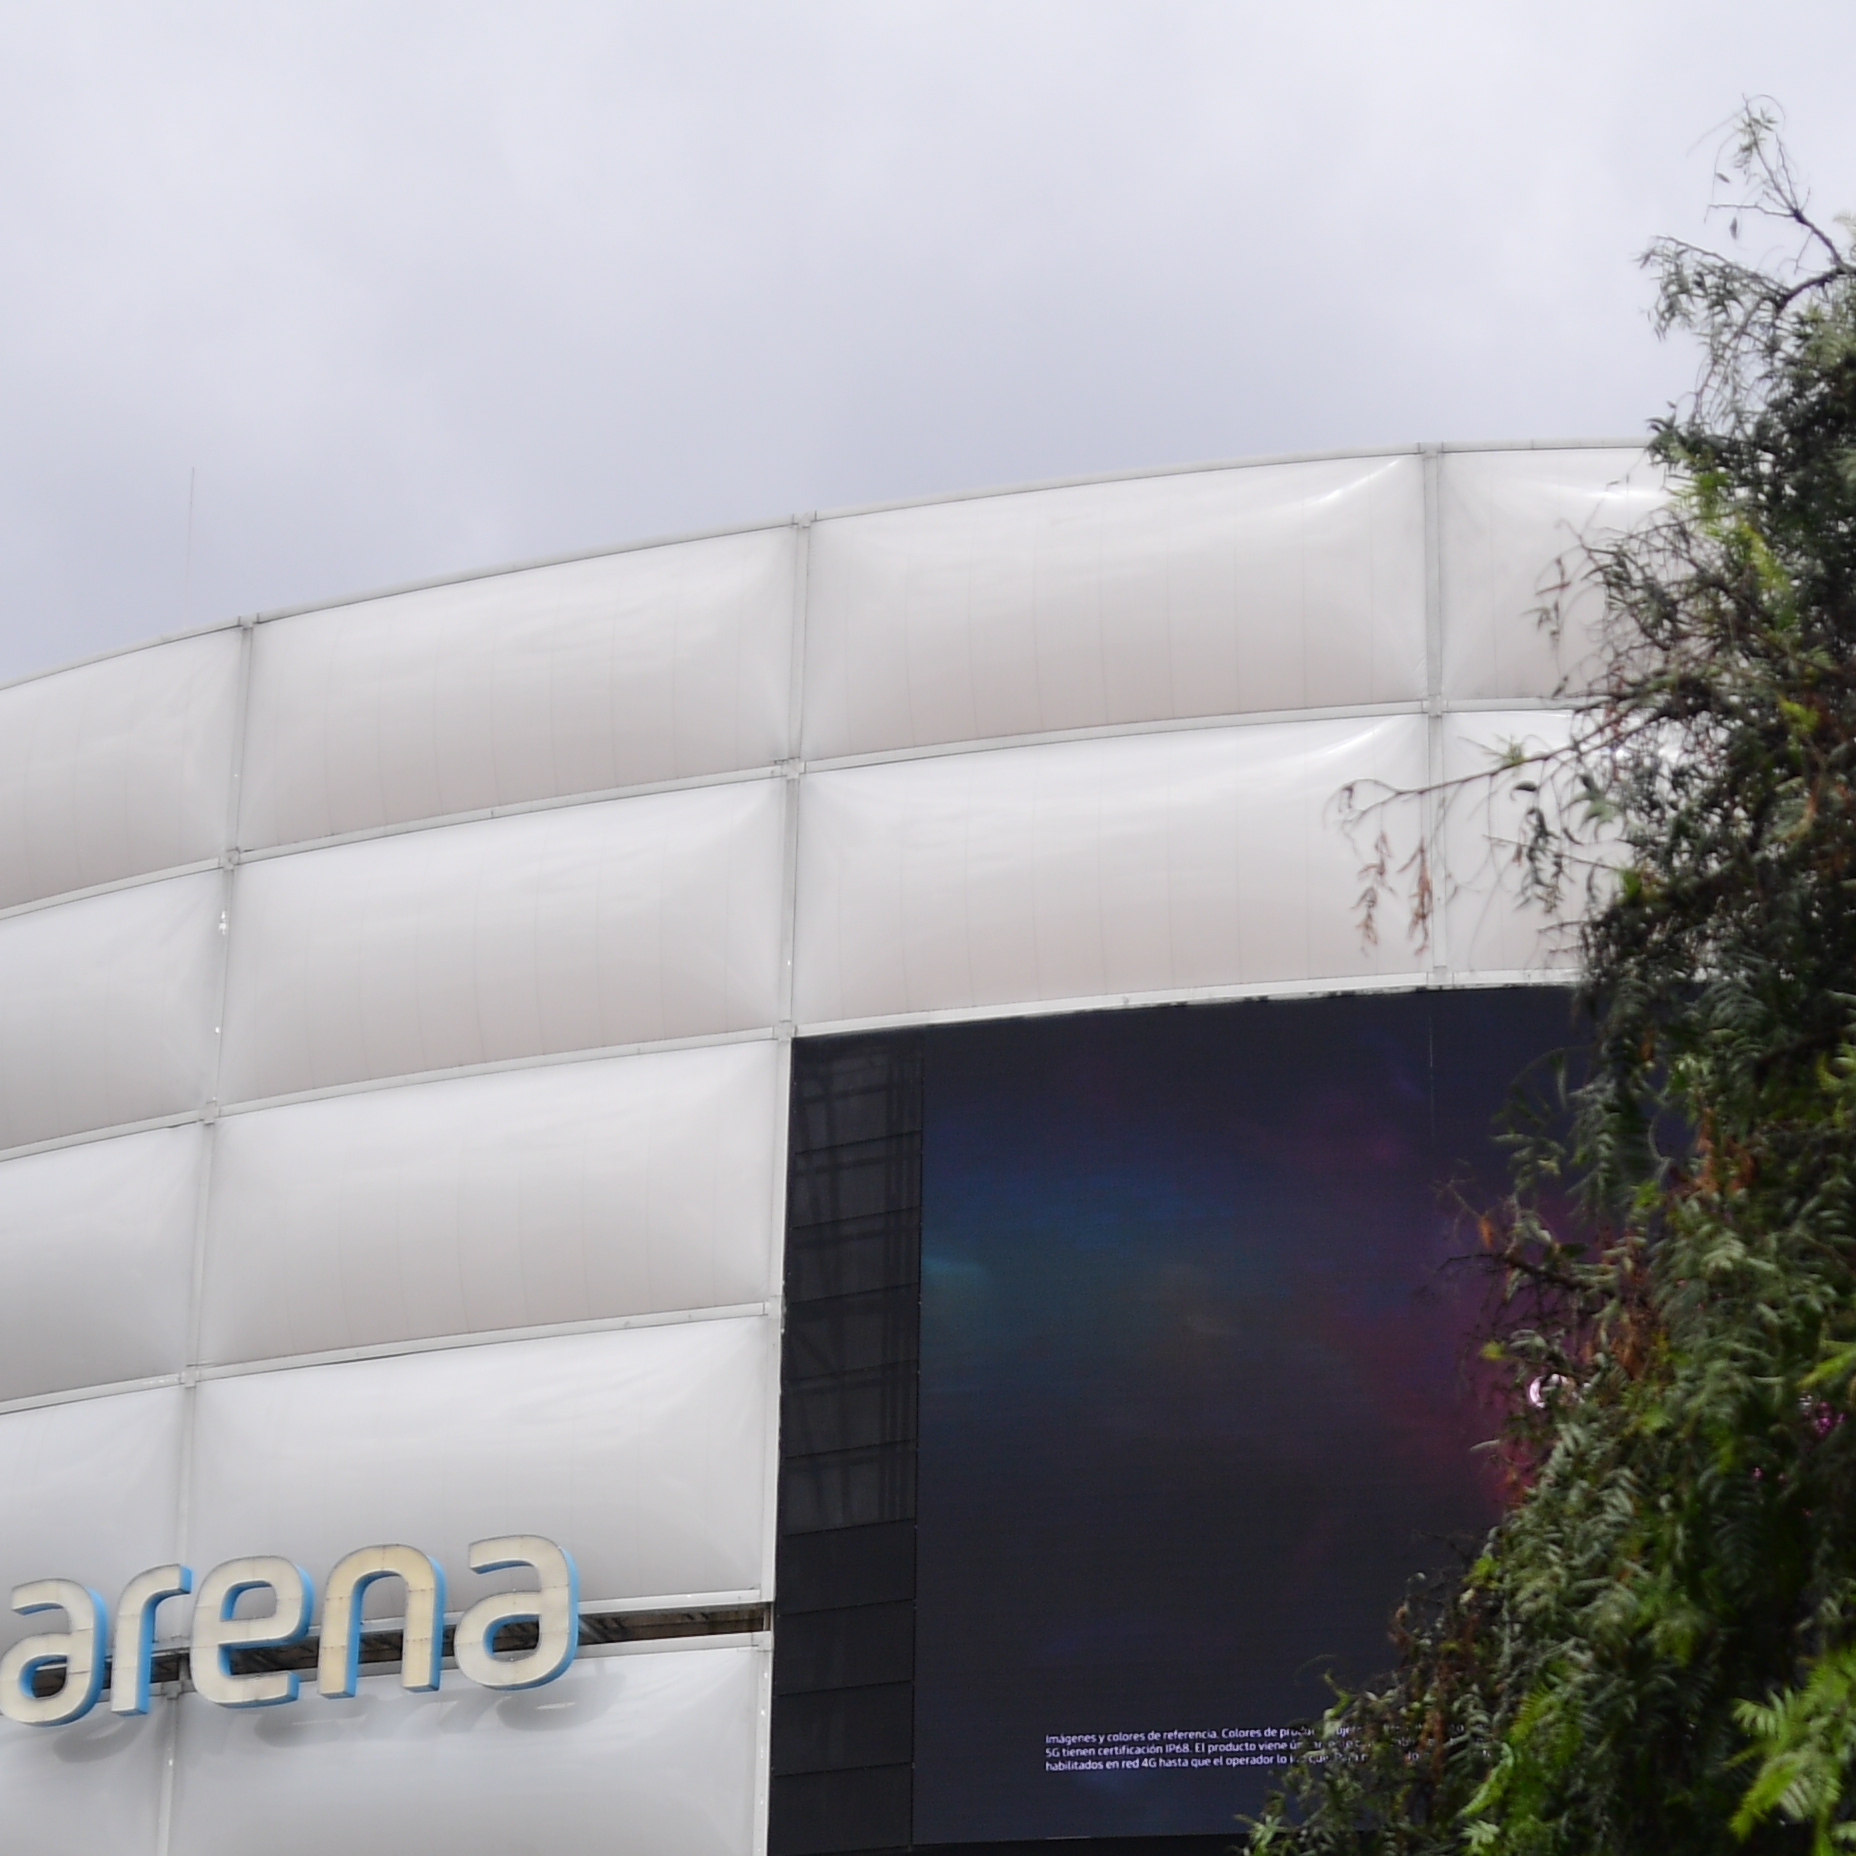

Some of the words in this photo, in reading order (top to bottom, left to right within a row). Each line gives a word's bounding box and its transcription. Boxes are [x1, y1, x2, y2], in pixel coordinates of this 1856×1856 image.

[1045, 1733, 1097, 1746] Imágenes
[1098, 1734, 1106, 1744] y
[1107, 1731, 1145, 1743] colores
[1147, 1730, 1161, 1741] de
[1163, 1728, 1219, 1741] referencia.
[1221, 1727, 1262, 1739] Colores
[1263, 1726, 1278, 1738] de
[1045, 1747, 1059, 1758] 5G
[1061, 1746, 1096, 1757] tienen
[1097, 1743, 1163, 1756] certificación
[1165, 1742, 1193, 1754] IP68.
[1195, 1742, 1206, 1753] El
[1207, 1741, 1257, 1755] producto
[1258, 1740, 1288, 1751] viene
[1045, 1759, 1104, 1772] habilitados
[1105, 1760, 1120, 1770] en
[1122, 1757, 1140, 1769] red
[1141, 1757, 1157, 1768] 4G
[1158, 1757, 1189, 1768] hasta
[1190, 1757, 1212, 1769] que
[1213, 1755, 1224, 1766] el
[1225, 1753, 1275, 1769] operador
[1276, 1753, 1288, 1764] lo
